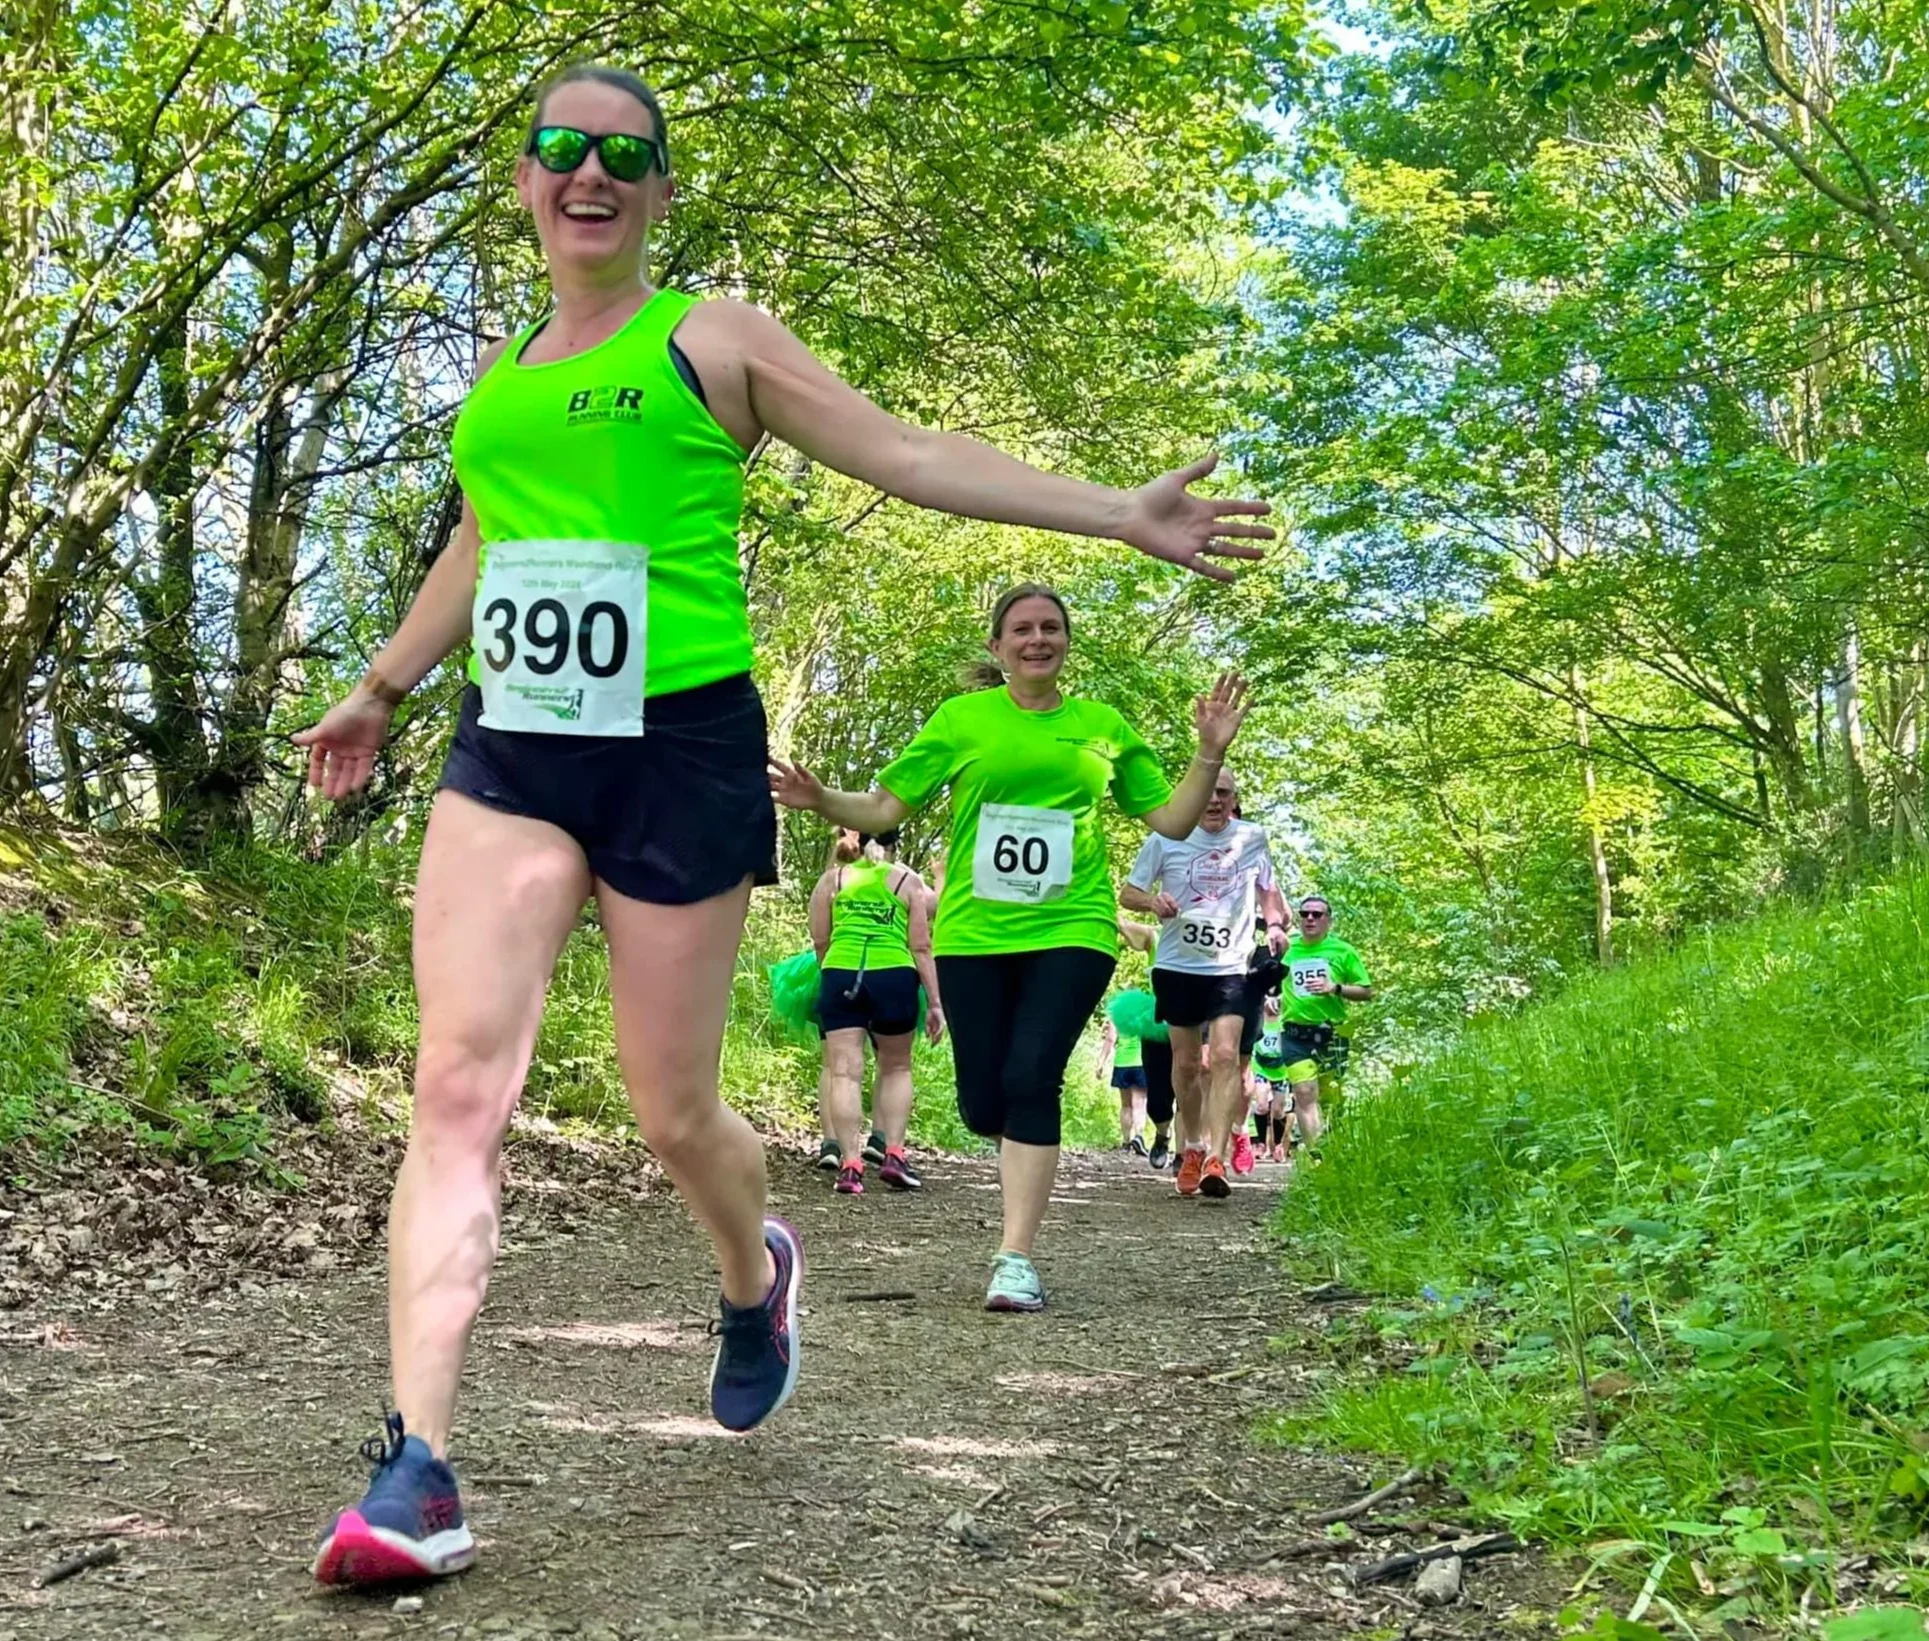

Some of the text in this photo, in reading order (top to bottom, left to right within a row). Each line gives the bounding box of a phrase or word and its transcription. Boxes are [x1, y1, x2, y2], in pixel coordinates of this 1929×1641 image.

[567, 385, 645, 413] B2R
[483, 597, 629, 678] 390
[993, 834, 1049, 875] 60
[1182, 923, 1232, 949] 353
